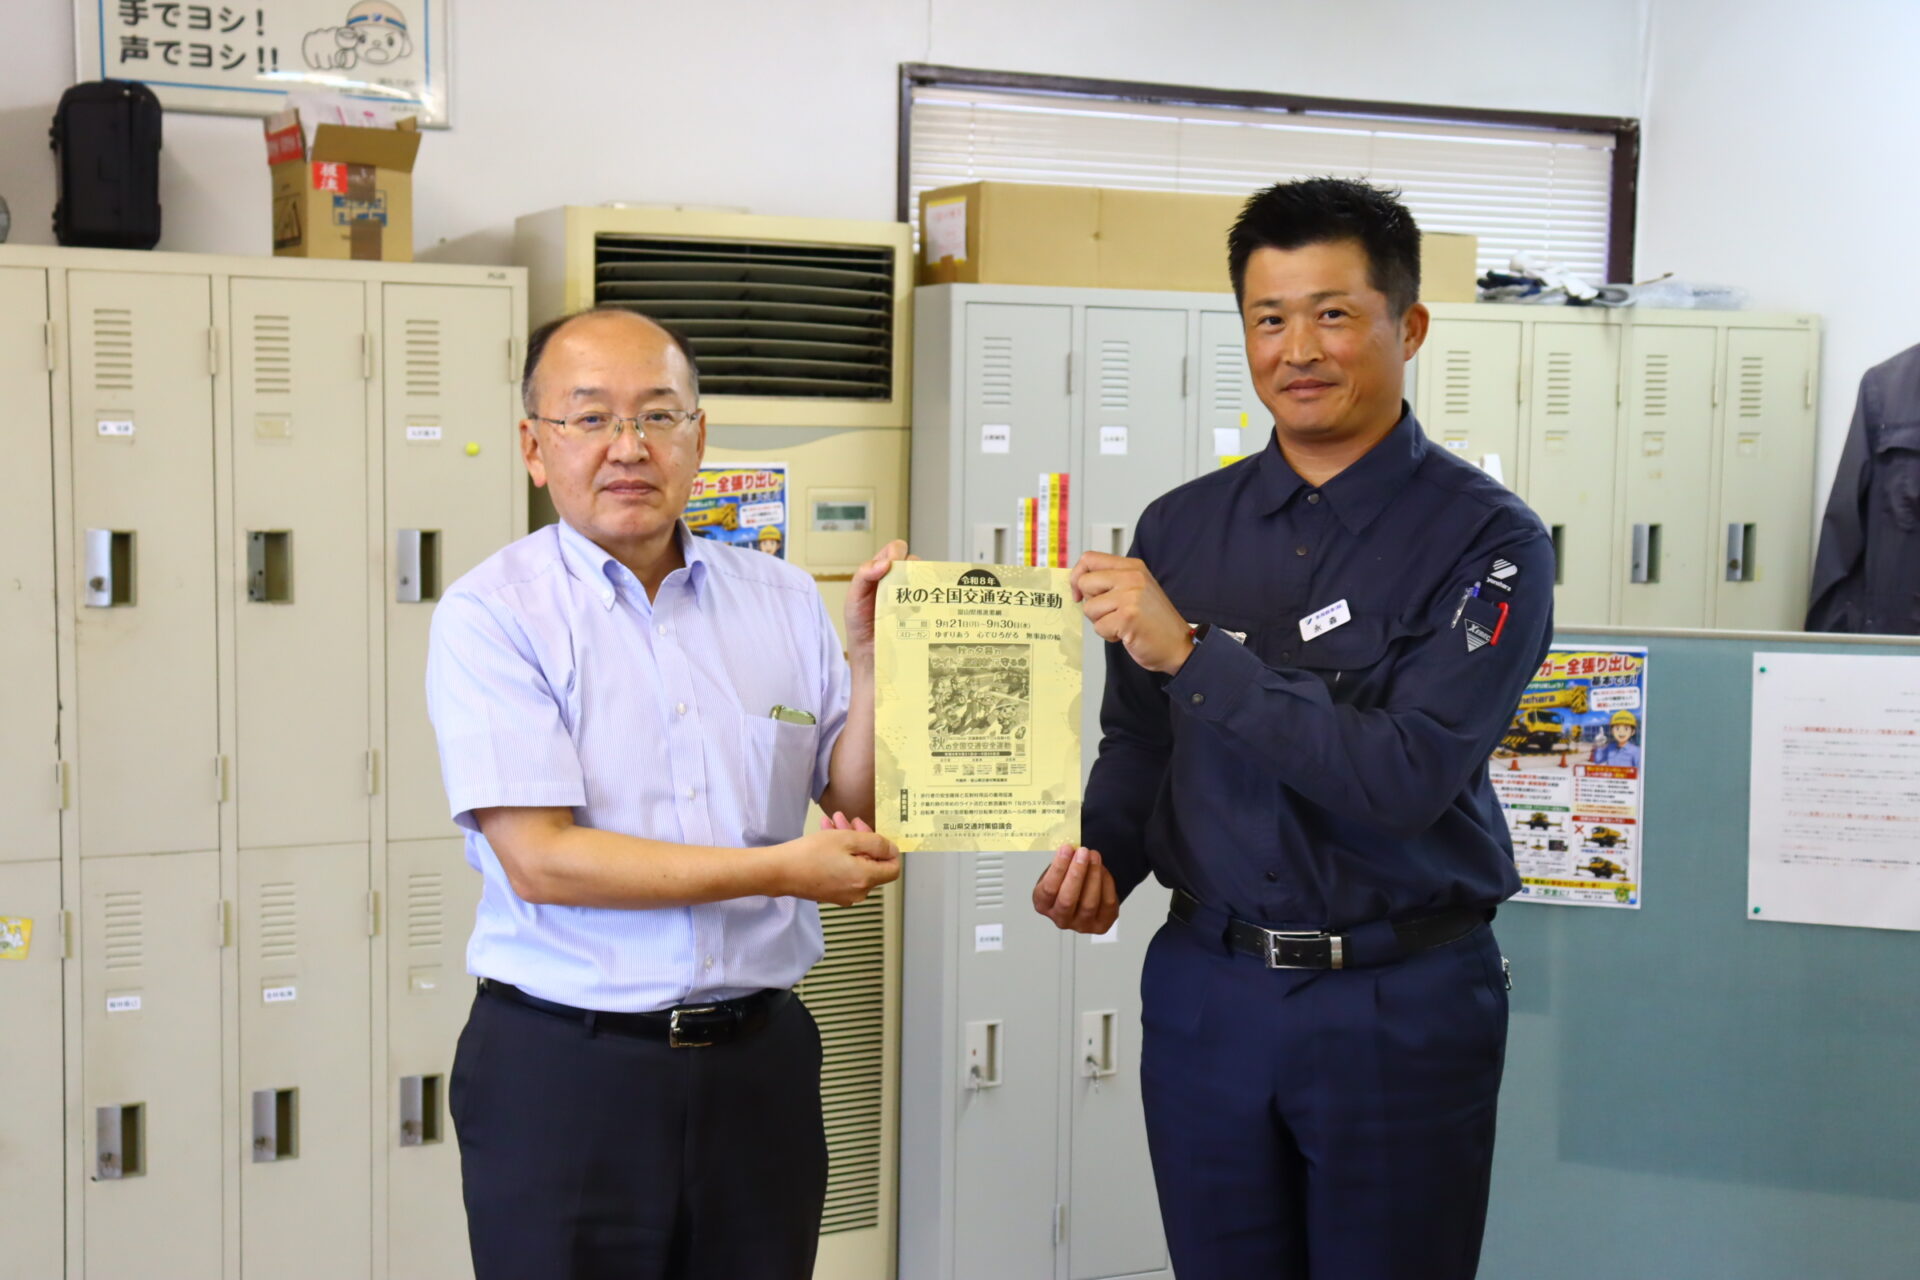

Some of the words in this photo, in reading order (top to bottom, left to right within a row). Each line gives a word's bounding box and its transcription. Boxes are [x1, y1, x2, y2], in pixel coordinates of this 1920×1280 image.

[118, 0, 264, 36] 手でヨシ!
[119, 34, 278, 73] 声でヨシ!!
[961, 576, 996, 585] 令和8年
[896, 587, 1063, 609] 秋の全国交通安全運動
[1539, 655, 1635, 677] ガー全張り出し
